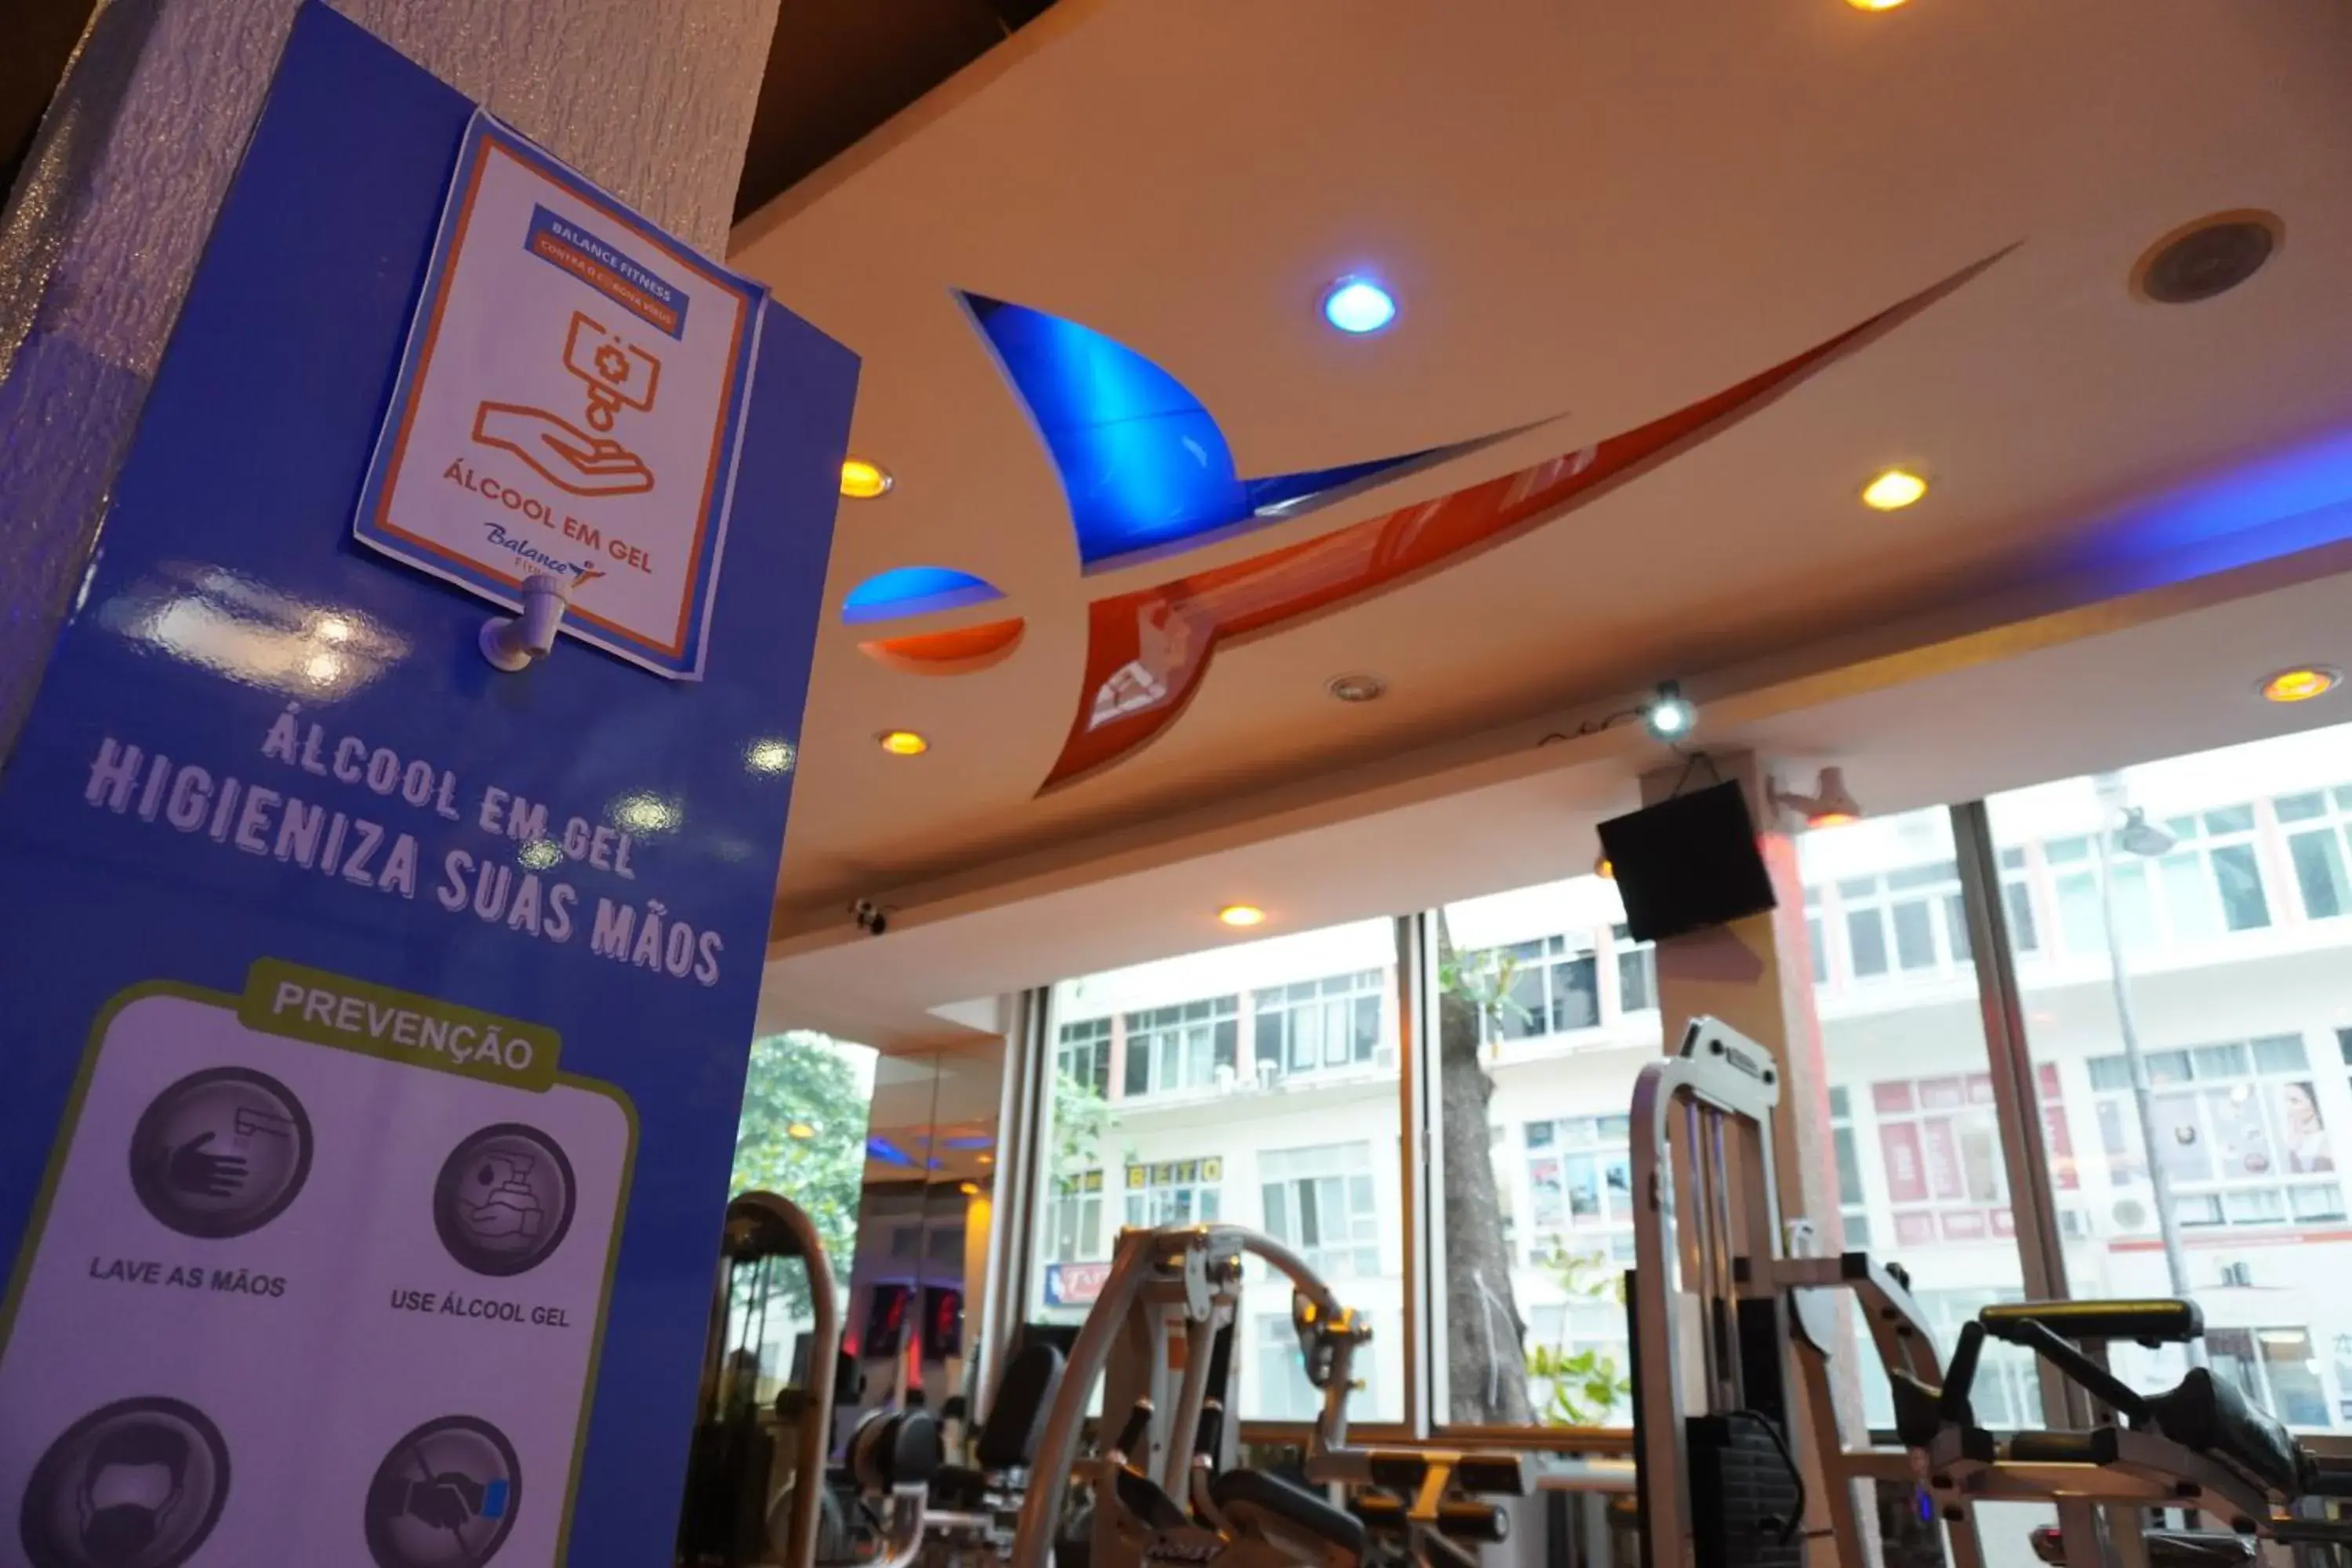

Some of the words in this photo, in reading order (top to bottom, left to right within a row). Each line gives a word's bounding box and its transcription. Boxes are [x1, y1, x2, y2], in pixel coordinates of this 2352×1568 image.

[552, 221, 618, 268] BALANCE
[620, 262, 672, 303] FITNESS
[443, 457, 556, 529] ÁLCOOL
[564, 515, 601, 550] EM
[608, 539, 652, 575] GEL
[484, 521, 568, 575] Balance
[260, 700, 460, 821] ÁLCOOL
[478, 785, 550, 841] EM
[561, 816, 636, 880] GEL
[85, 737, 419, 899] HIGIENIZA
[437, 848, 579, 943] SUAS
[590, 898, 724, 988] MÃOS
[273, 981, 533, 1070] PREVENÇÃO
[89, 1256, 162, 1284] LAVE
[165, 1265, 204, 1290] AS
[211, 1268, 288, 1298] MÃOS
[390, 1289, 436, 1313] USE
[439, 1290, 525, 1323] ÁLCOOL
[531, 1305, 571, 1328] GEL
